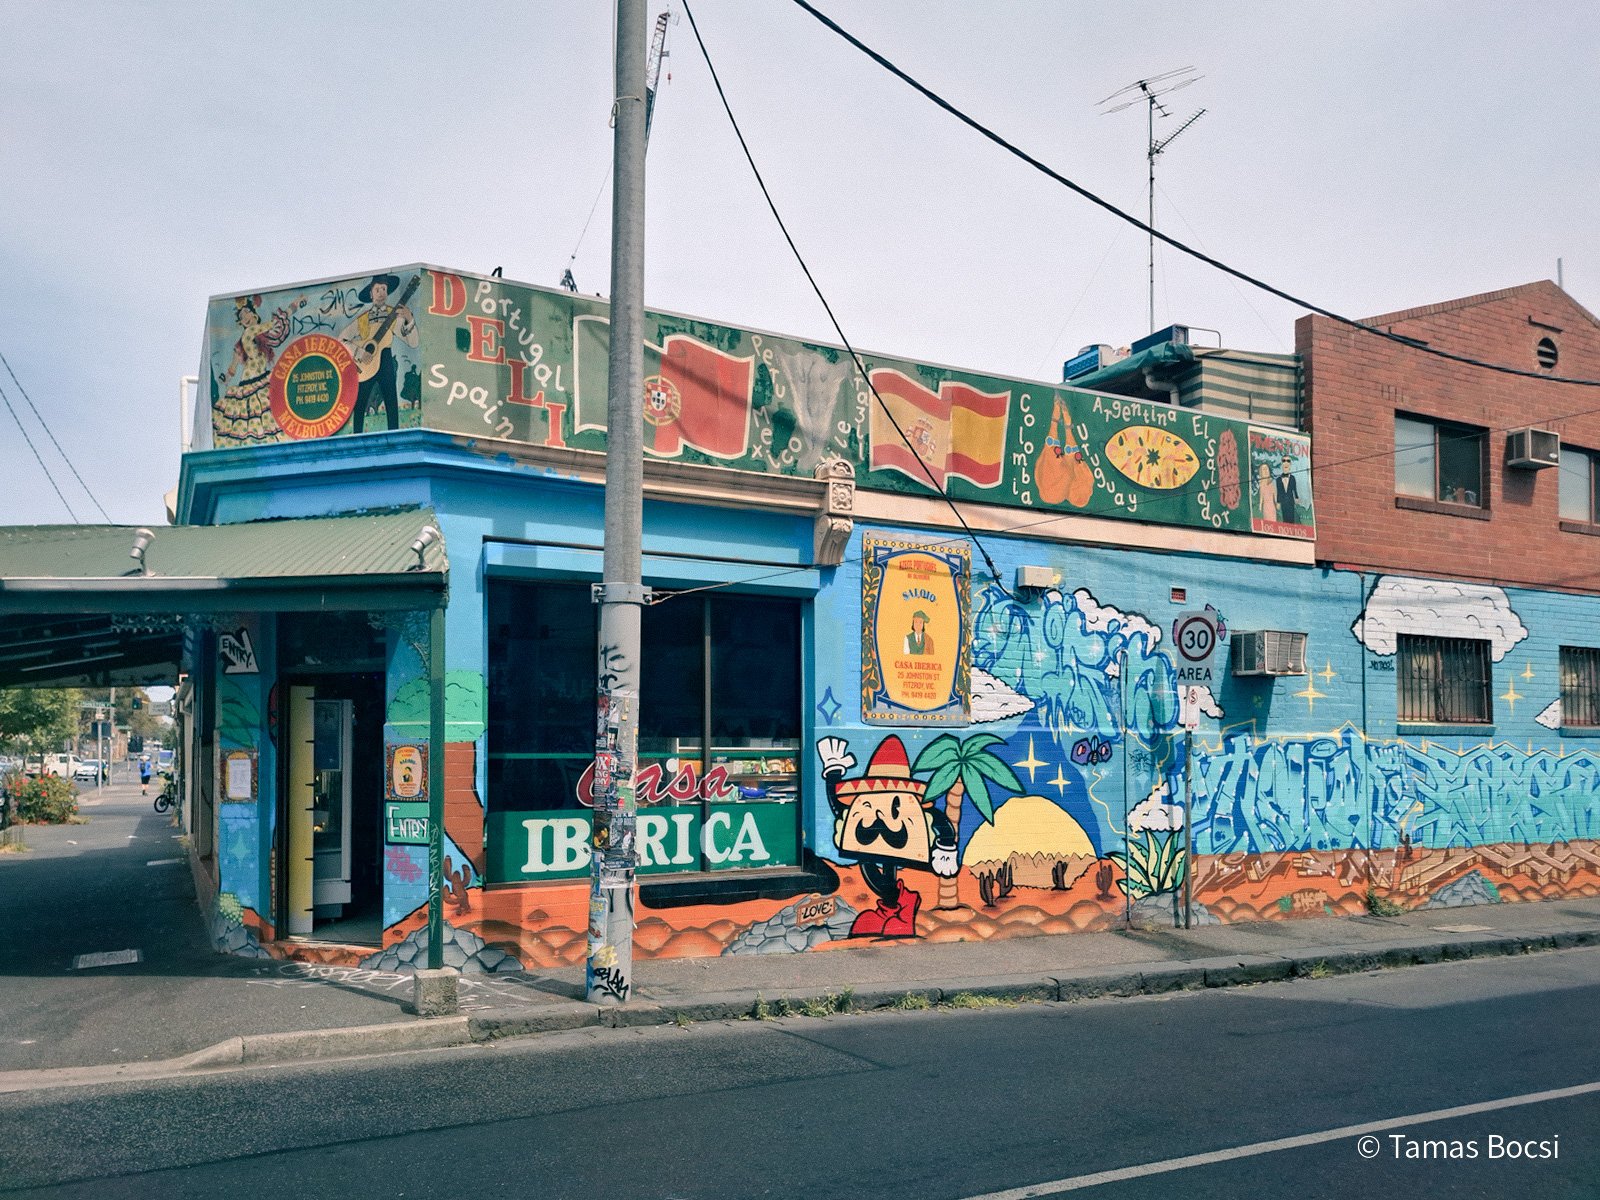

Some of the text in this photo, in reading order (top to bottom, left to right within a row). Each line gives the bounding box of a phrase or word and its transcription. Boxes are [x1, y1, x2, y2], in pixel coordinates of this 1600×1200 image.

[275, 345, 302, 379] CASA
[428, 271, 566, 447] DELI
[474, 281, 564, 391] Portugal
[751, 335, 785, 398] Peru
[278, 402, 350, 438] MELBOURNE
[428, 364, 514, 439] Spain
[1092, 397, 1177, 426] Argentina
[751, 406, 802, 469] Mexico
[1012, 393, 1035, 505] Colombia
[1076, 423, 1137, 512] Uruguay
[1192, 415, 1230, 528] El Salvador
[894, 660, 914, 669] CASA
[1184, 630, 1209, 649] 30
[1178, 668, 1212, 680] AREA
[389, 806, 429, 839] ENTRY
[521, 811, 770, 873] IBRICA
